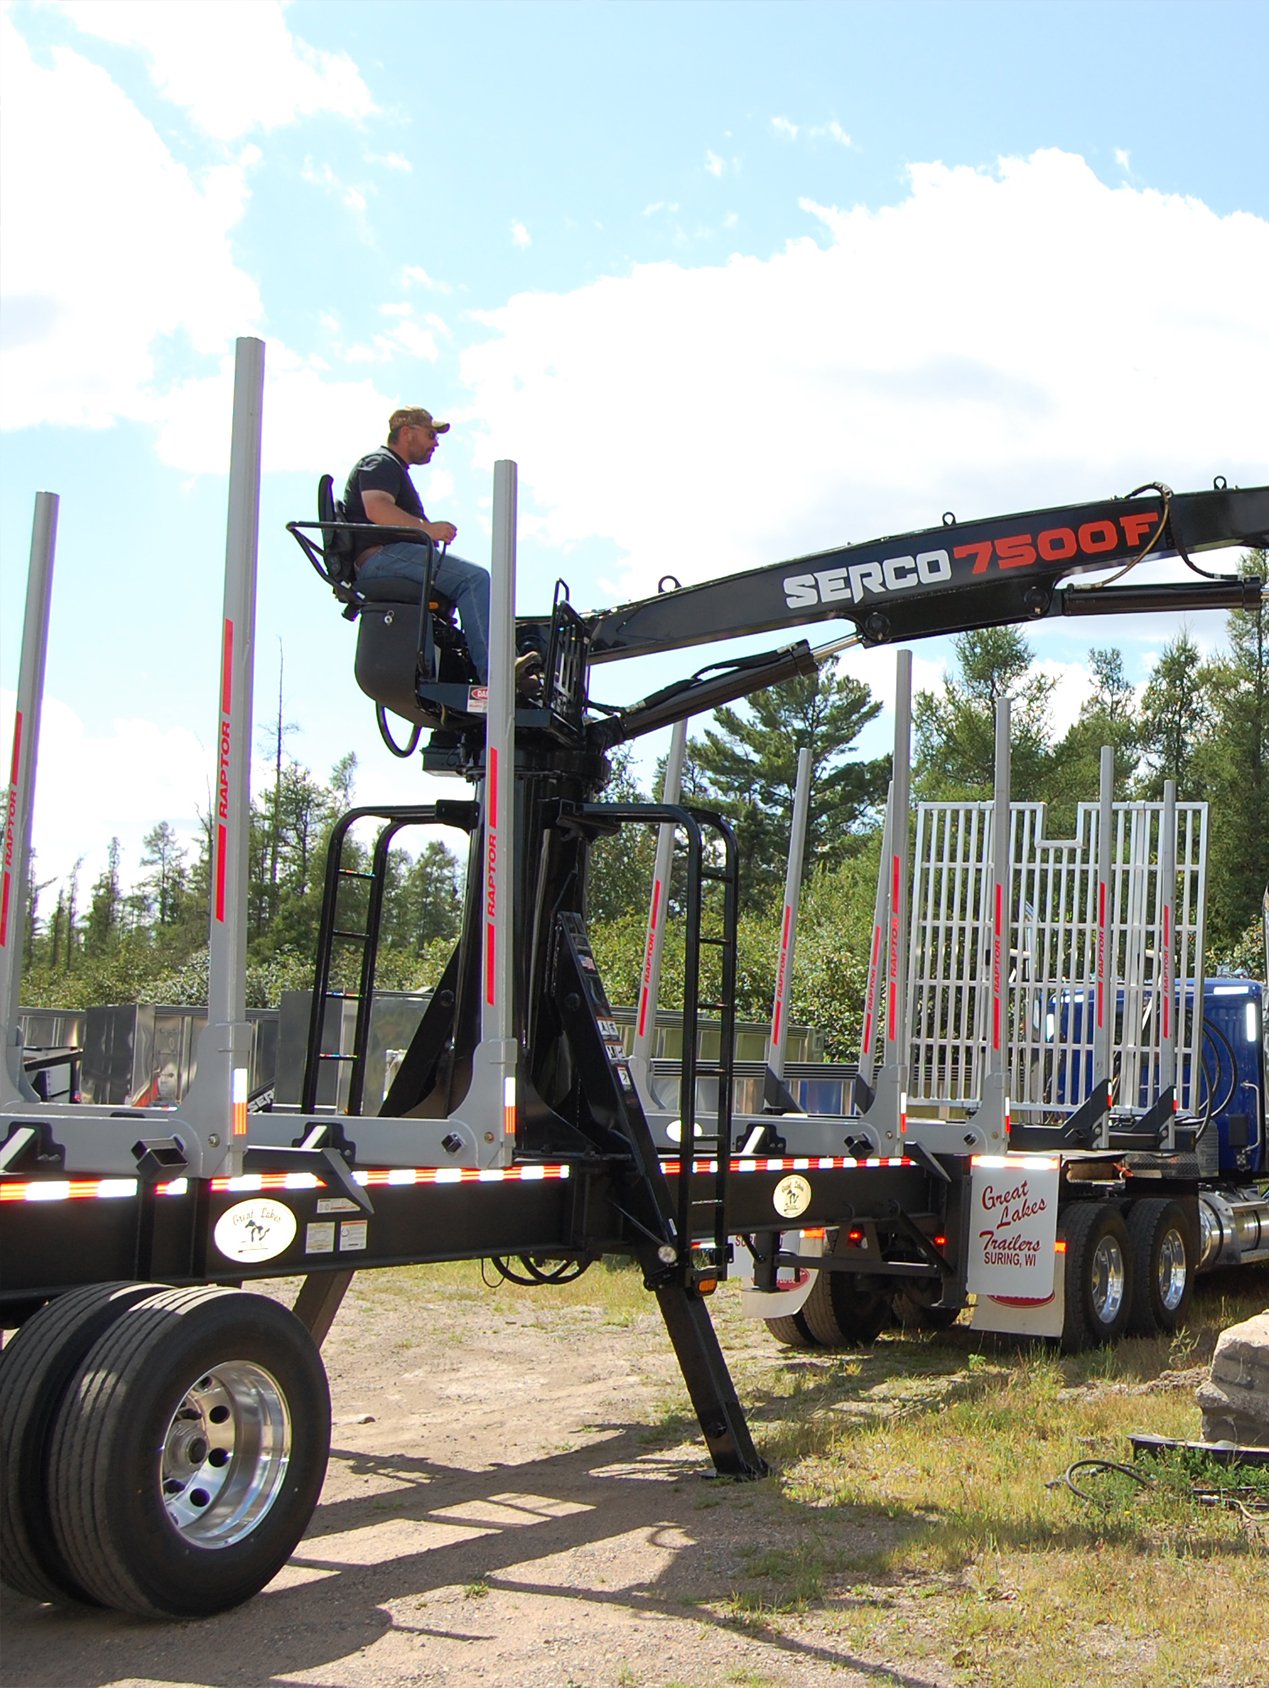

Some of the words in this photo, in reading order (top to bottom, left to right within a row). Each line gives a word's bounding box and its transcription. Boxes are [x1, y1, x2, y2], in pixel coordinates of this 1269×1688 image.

[782, 549, 952, 610] SERCO
[953, 512, 1159, 575] 7500F
[219, 720, 232, 820] RAPTOR
[5, 790, 17, 867] RAPTOR
[487, 833, 497, 917] RAPTOR
[644, 933, 656, 984] RAPTOR
[890, 917, 900, 978] RAPTOR
[778, 952, 787, 998] RAPTOR
[868, 969, 877, 1011] RAPTOR
[982, 1180, 1029, 1210] Great
[996, 1198, 1047, 1230] Lakes
[979, 1230, 1041, 1252] Trailers
[984, 1251, 1022, 1268] SURING,
[1024, 1253, 1037, 1267] WI
